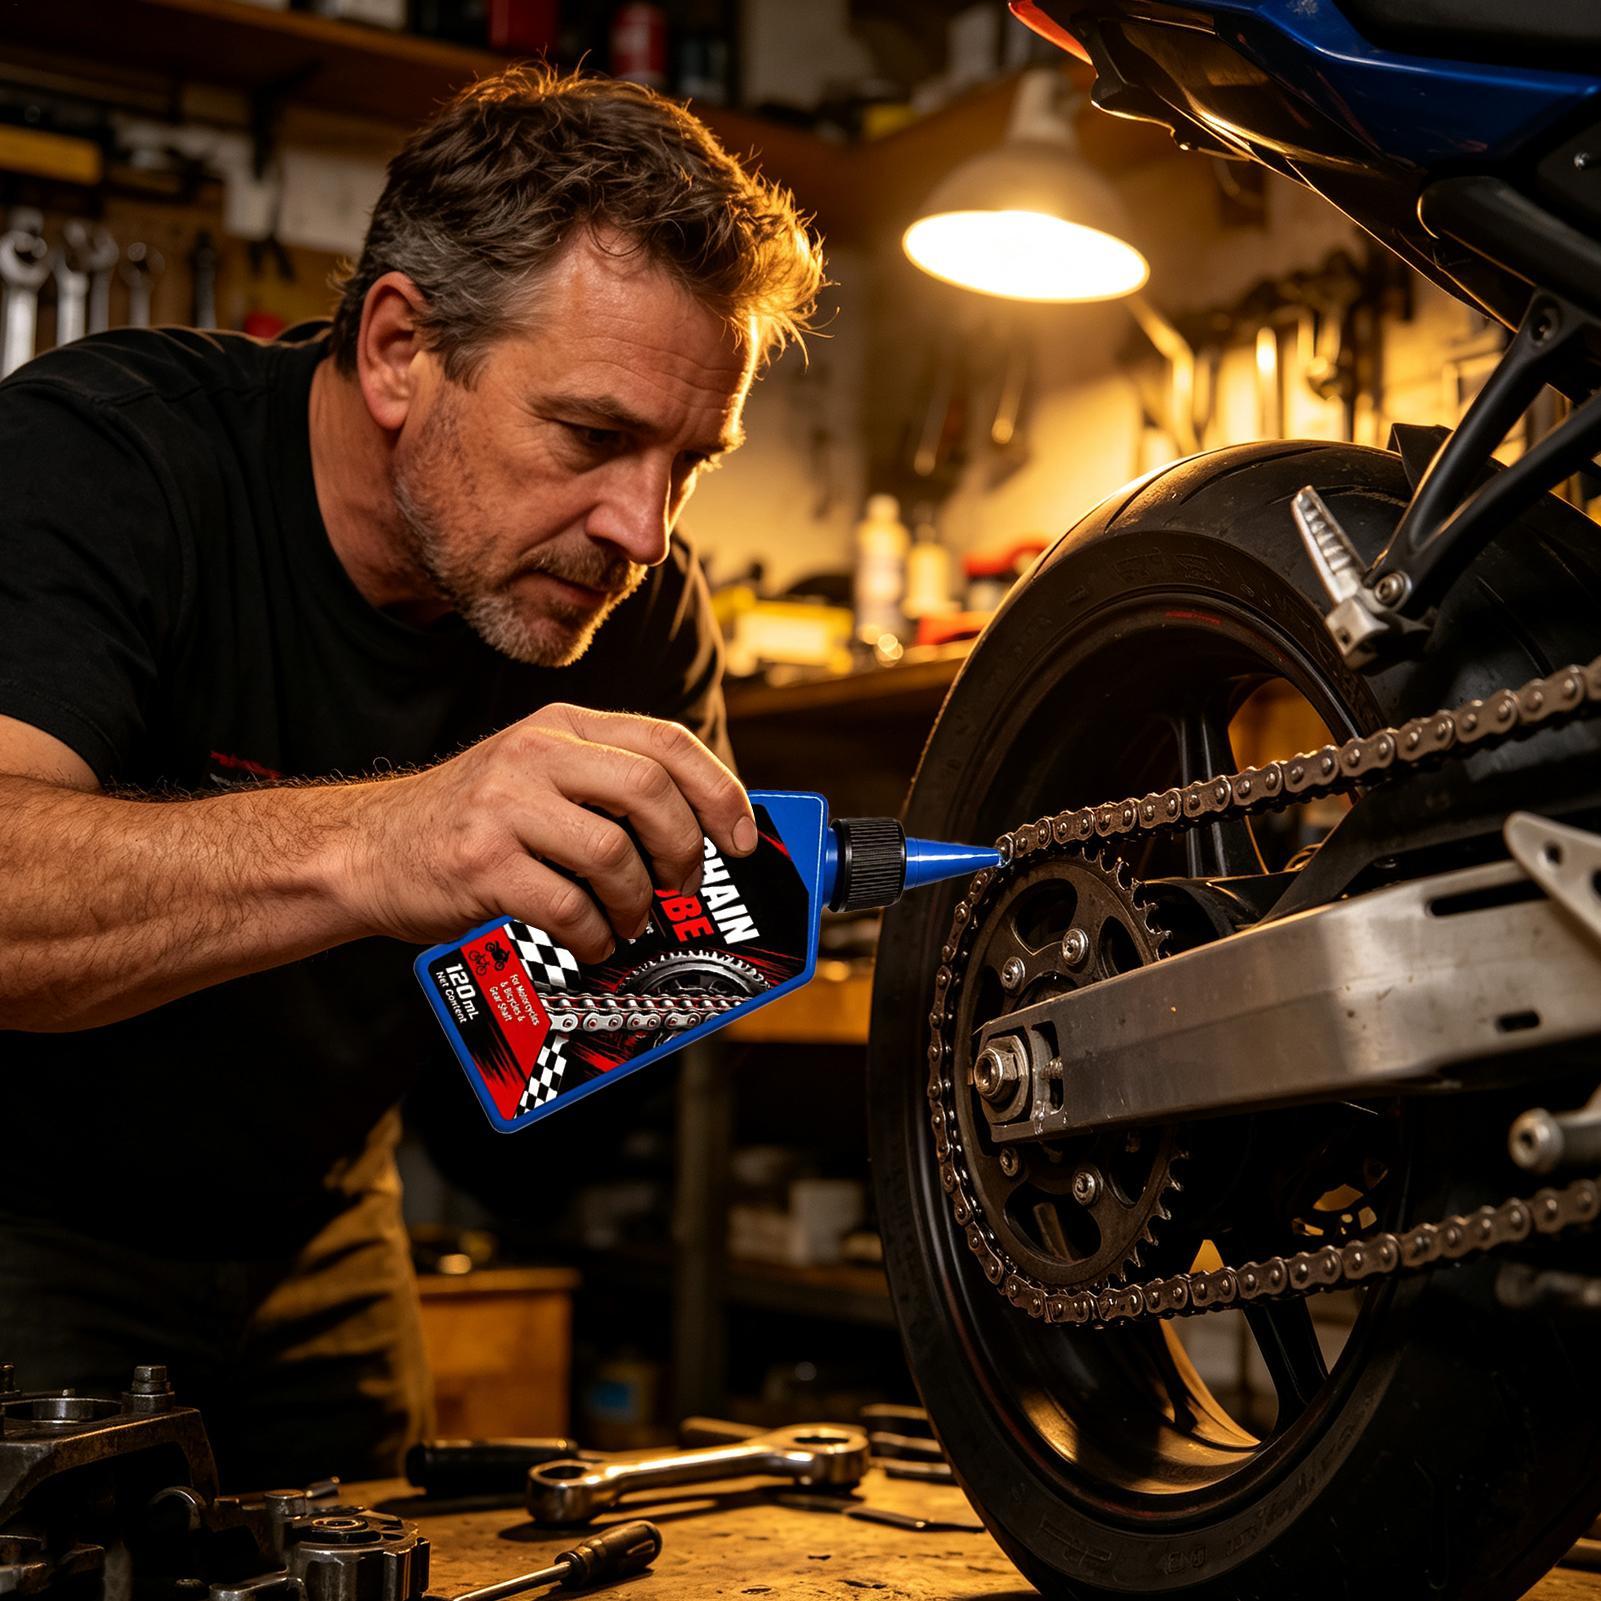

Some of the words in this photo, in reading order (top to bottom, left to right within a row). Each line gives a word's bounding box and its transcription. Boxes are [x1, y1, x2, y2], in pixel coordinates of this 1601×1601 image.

[655, 889, 715, 942] BE
[435, 971, 449, 987] Net
[445, 988, 467, 1023] Content
[489, 986, 502, 1003] Gear
[497, 1002, 513, 1022] Shaft
[503, 987, 521, 1016] Bicycles
[510, 974, 520, 985] For
[516, 985, 540, 1026] Motorcycles
